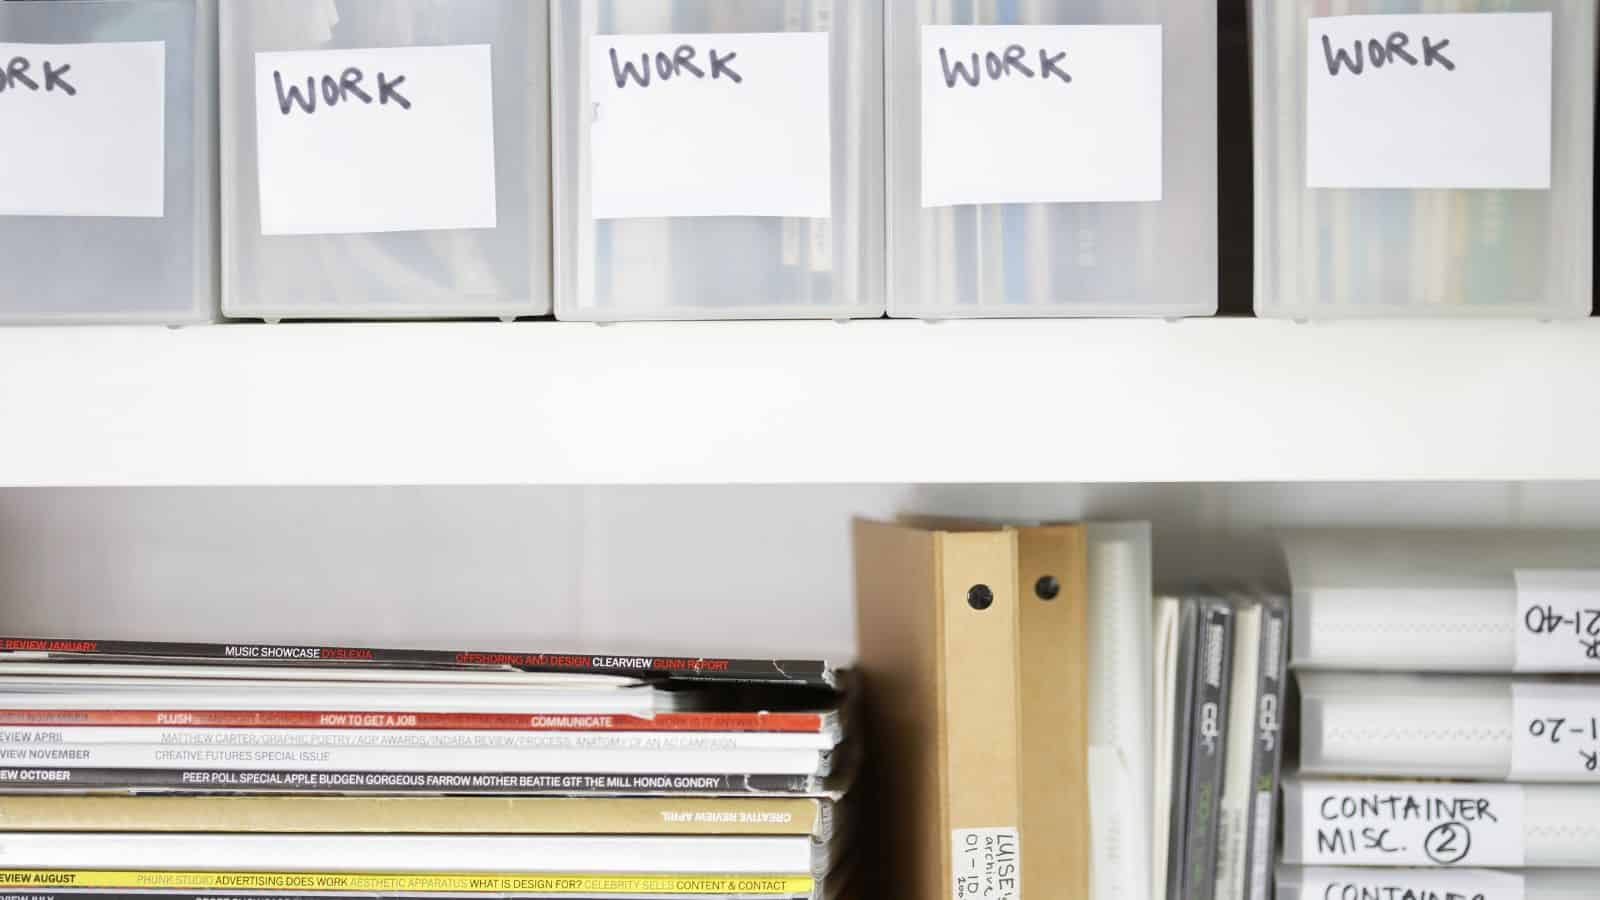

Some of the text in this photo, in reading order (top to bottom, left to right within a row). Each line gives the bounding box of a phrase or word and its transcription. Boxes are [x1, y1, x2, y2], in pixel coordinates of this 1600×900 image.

[1321, 31, 1455, 76] WORK
[609, 44, 742, 88] WORK
[938, 44, 1072, 88] WORK
[273, 67, 411, 115] WORK
[6, 640, 47, 650] REVIEW
[49, 640, 97, 651] JANUARY
[225, 646, 373, 660] MUSIC SHOWCASE DYSLEXIA
[456, 654, 729, 671] OFFSHORING AND DESIGN CLEARVIEW GUNN REPORT
[157, 713, 192, 724] PLUSH
[320, 714, 347, 726] HOW
[348, 715, 362, 726] TO
[364, 715, 385, 726] GET
[385, 715, 394, 726] A
[395, 715, 416, 726] JOB
[531, 716, 613, 728] COMMUNICATE
[34, 732, 64, 744] APRIL
[160, 733, 212, 745] MATTHEW
[29, 749, 90, 760] NOVEMBER
[155, 750, 330, 761] CREATIVE FUTURES SPECIAL ISSUE
[20, 770, 71, 781] OCTOBER
[183, 772, 720, 788] PEER POLL SPECIAL APPLE BUDGEN GORGEOUS FARROW MOTHER BEATTIE GTF THE MILL HONDA GONDRY
[1320, 795, 1499, 822] CONTAINER
[661, 811, 792, 823] CREATIVE REVIEW APRIL
[1318, 828, 1407, 855] MISC.
[984, 836, 995, 896] archive
[996, 834, 1016, 900] LUISE'
[33, 874, 77, 884] AUGUST
[137, 874, 786, 891] PHUNK STUDIO ADVERTISING DOES WORK AESTHETIC APPARATUS WHAT IS DESIGN FOR? CELEBRITY SELLS CONTENT & CONTACT
